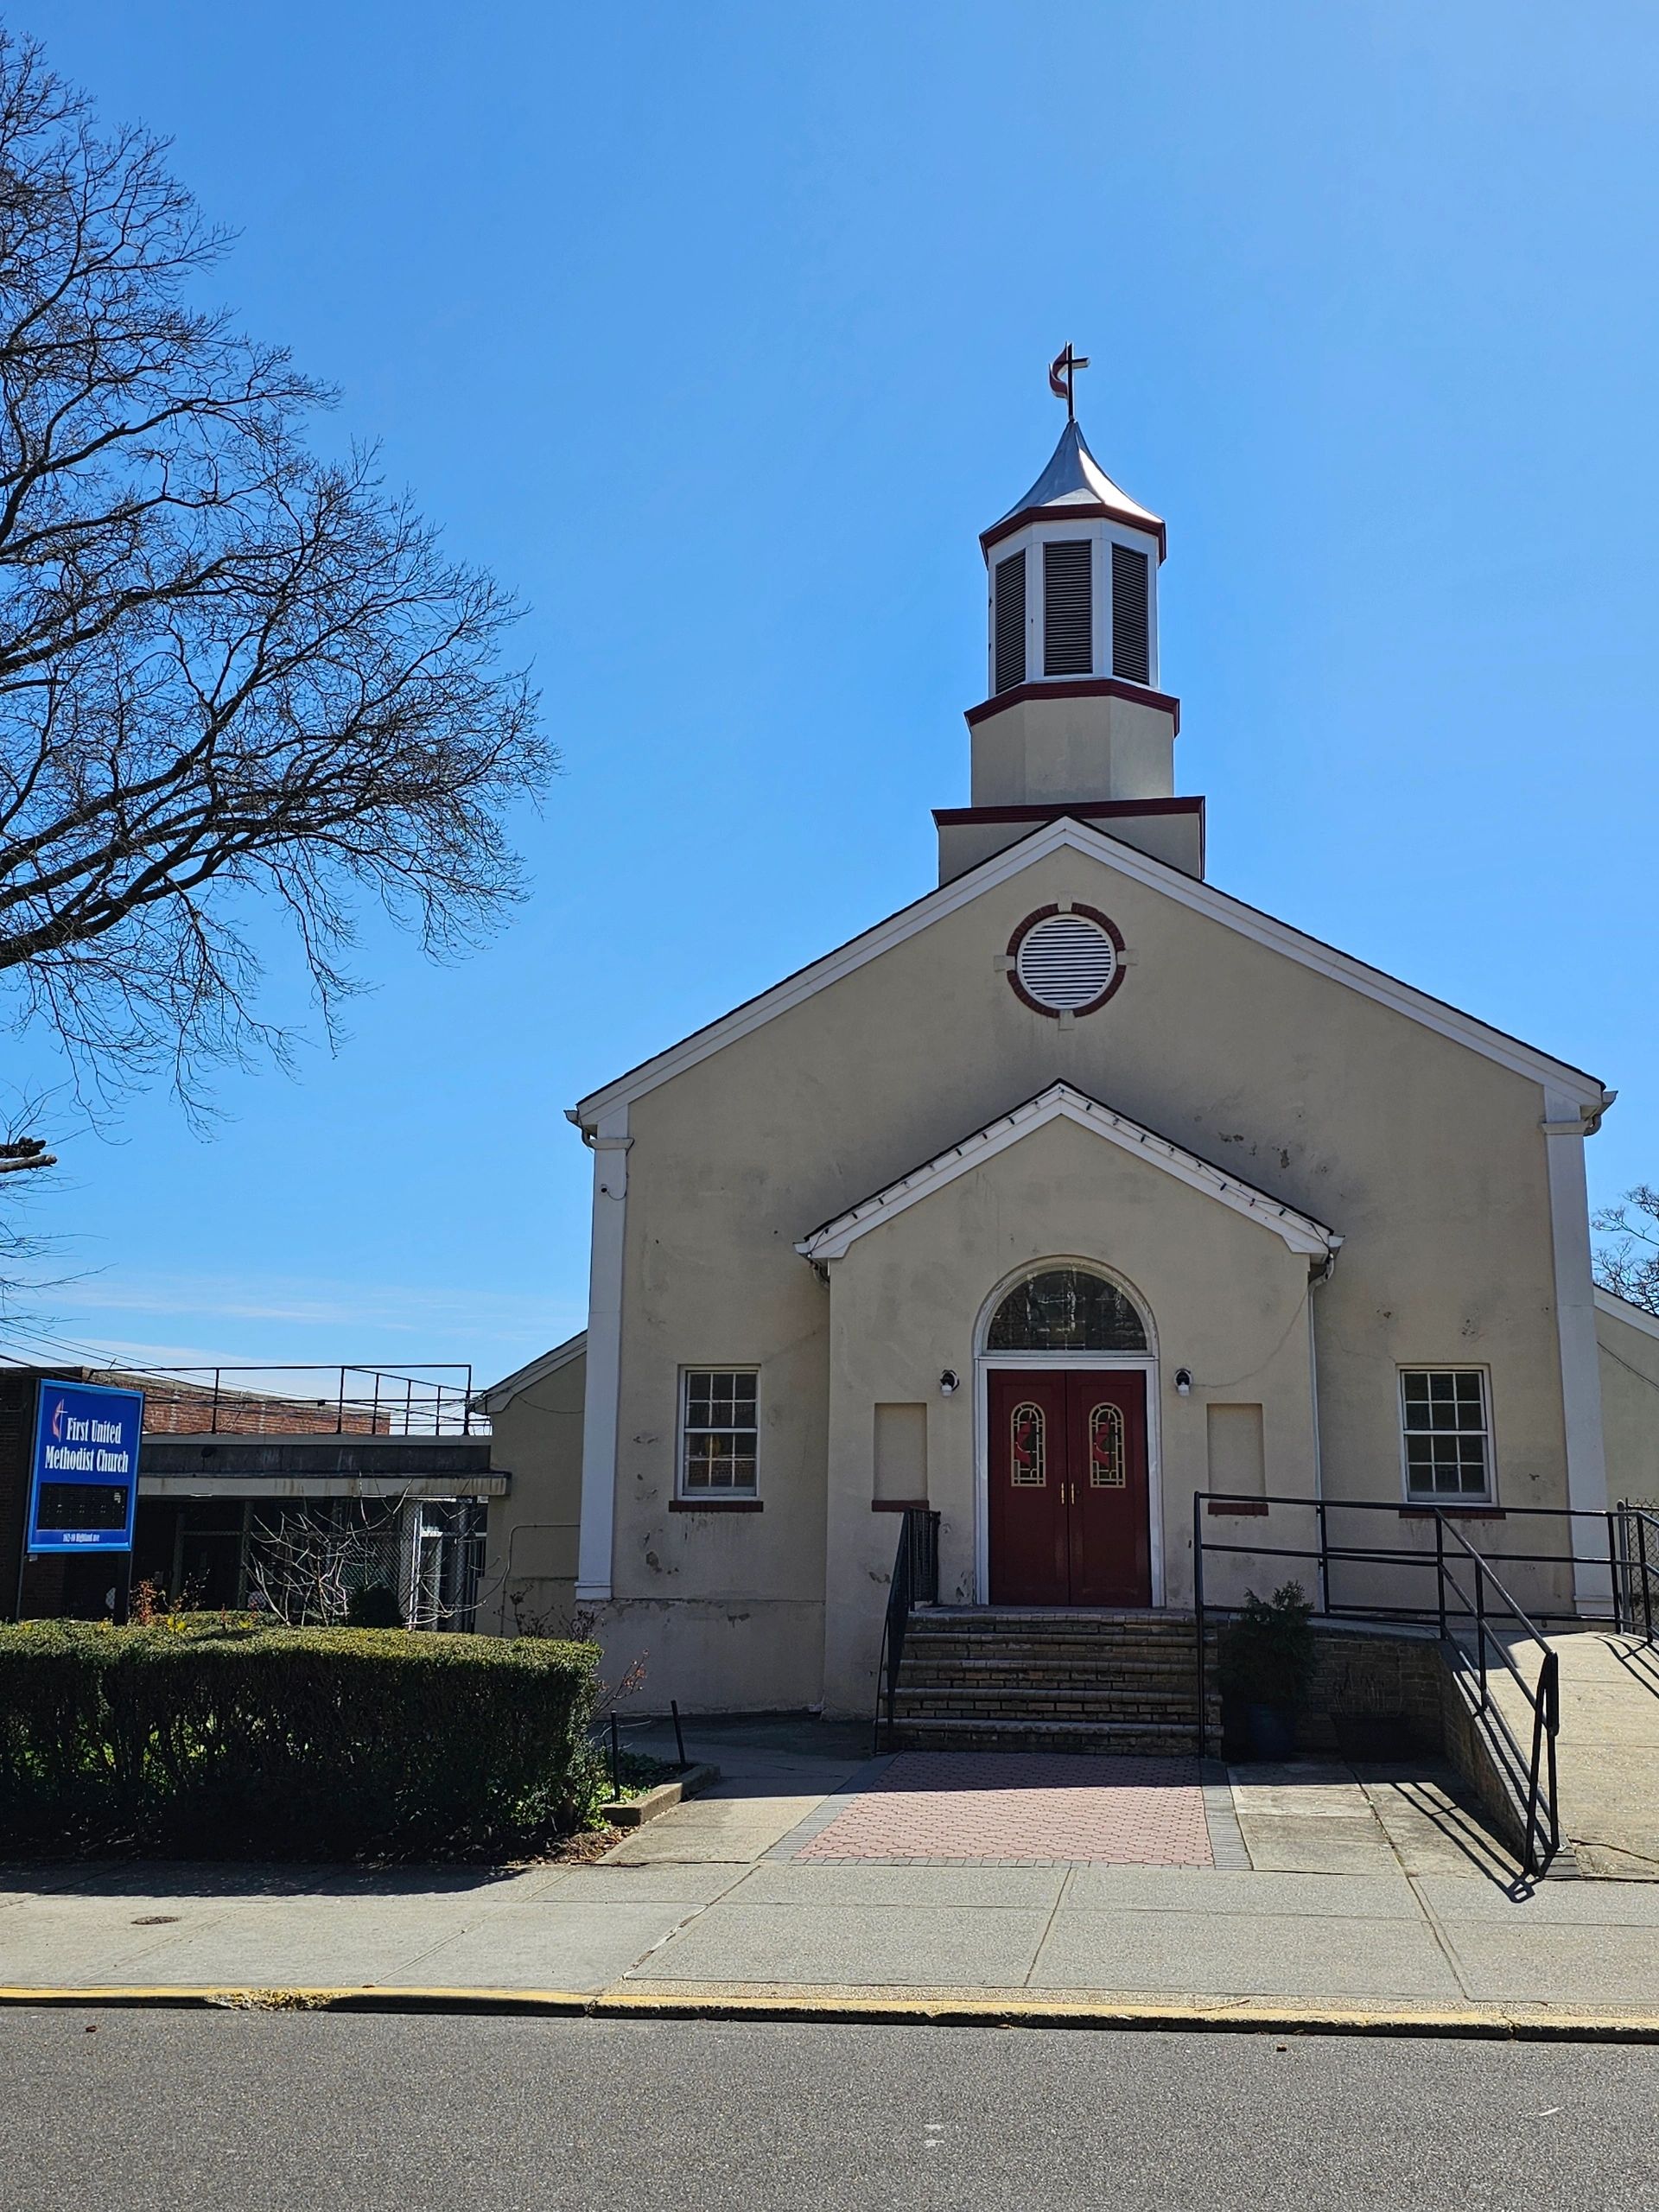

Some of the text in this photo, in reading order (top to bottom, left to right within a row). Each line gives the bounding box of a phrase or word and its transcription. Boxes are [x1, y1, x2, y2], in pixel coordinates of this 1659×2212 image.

[66, 1417, 122, 1444] First United
[45, 1445, 129, 1473] Methodist Church
